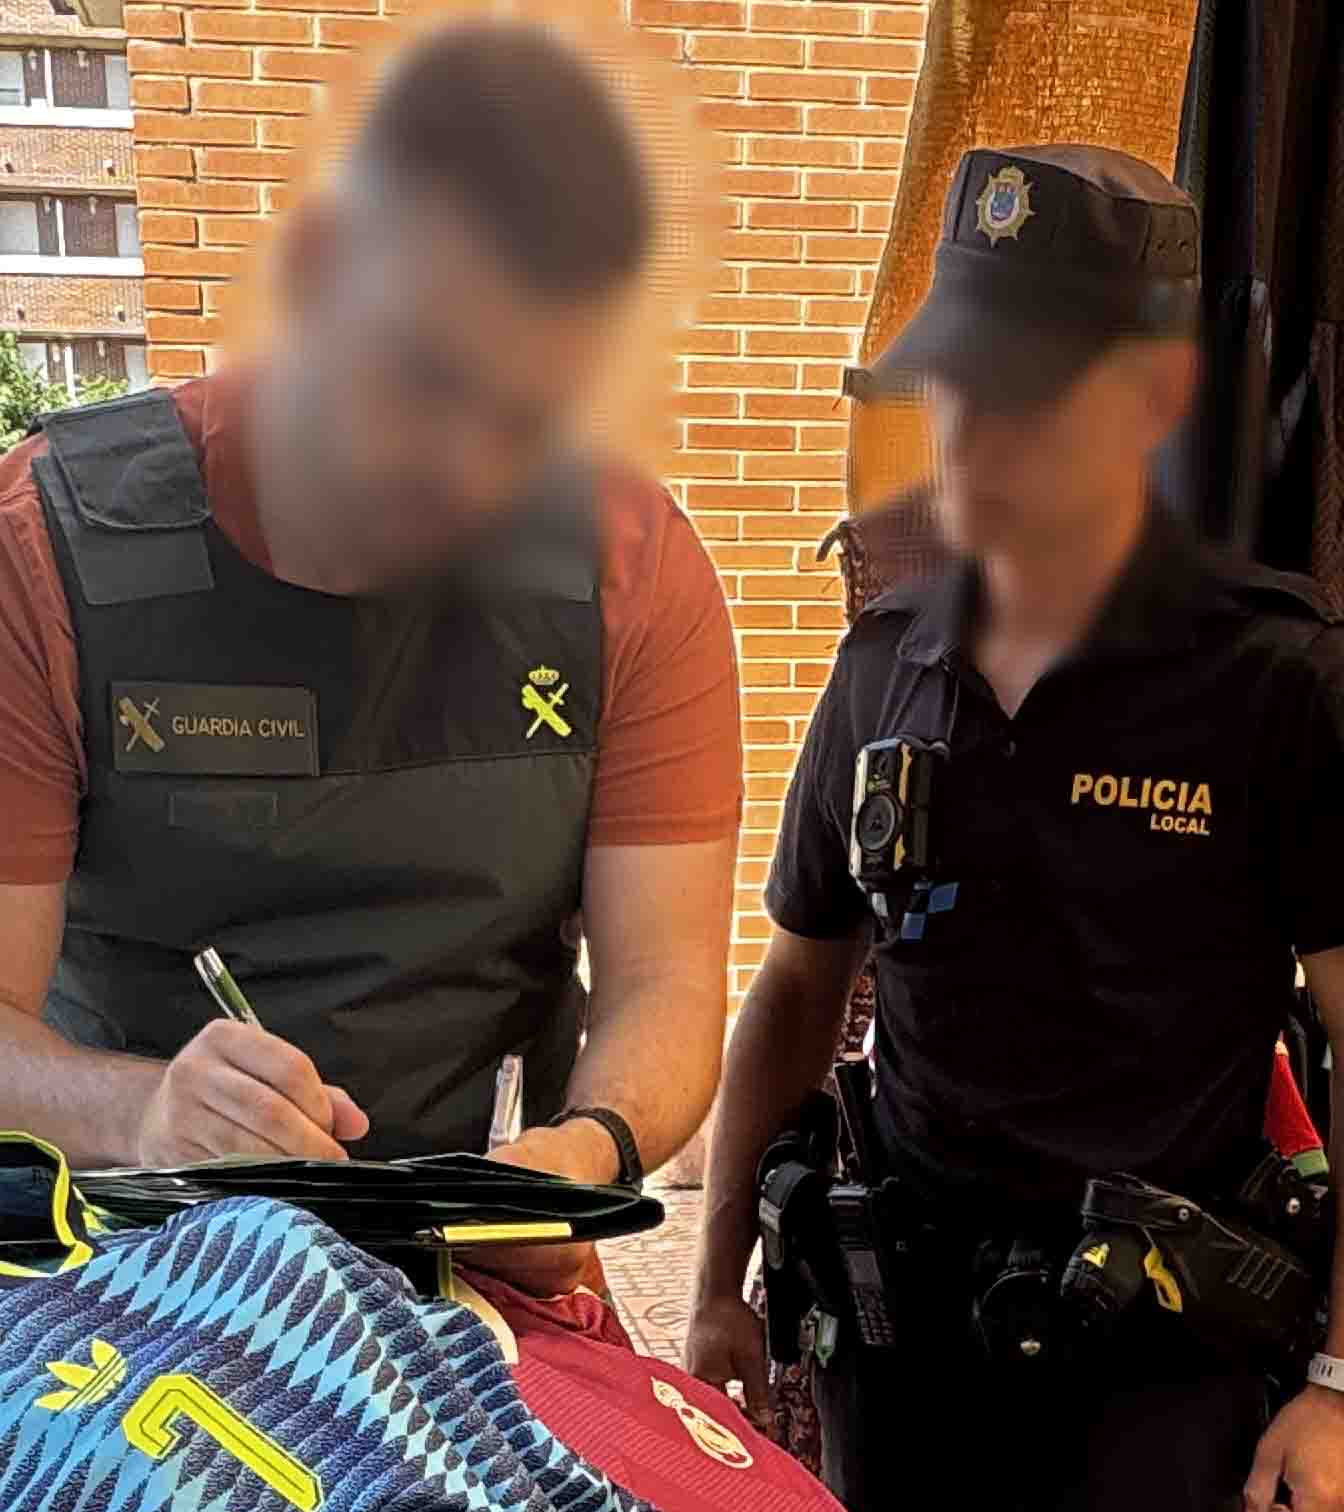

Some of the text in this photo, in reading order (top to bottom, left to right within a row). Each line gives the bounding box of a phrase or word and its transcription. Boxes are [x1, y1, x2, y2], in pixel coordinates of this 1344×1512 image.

[171, 715, 305, 737] GUARDIA CIVIL
[1071, 773, 1213, 816] POLICIA
[1150, 813, 1211, 836] LOCAL
